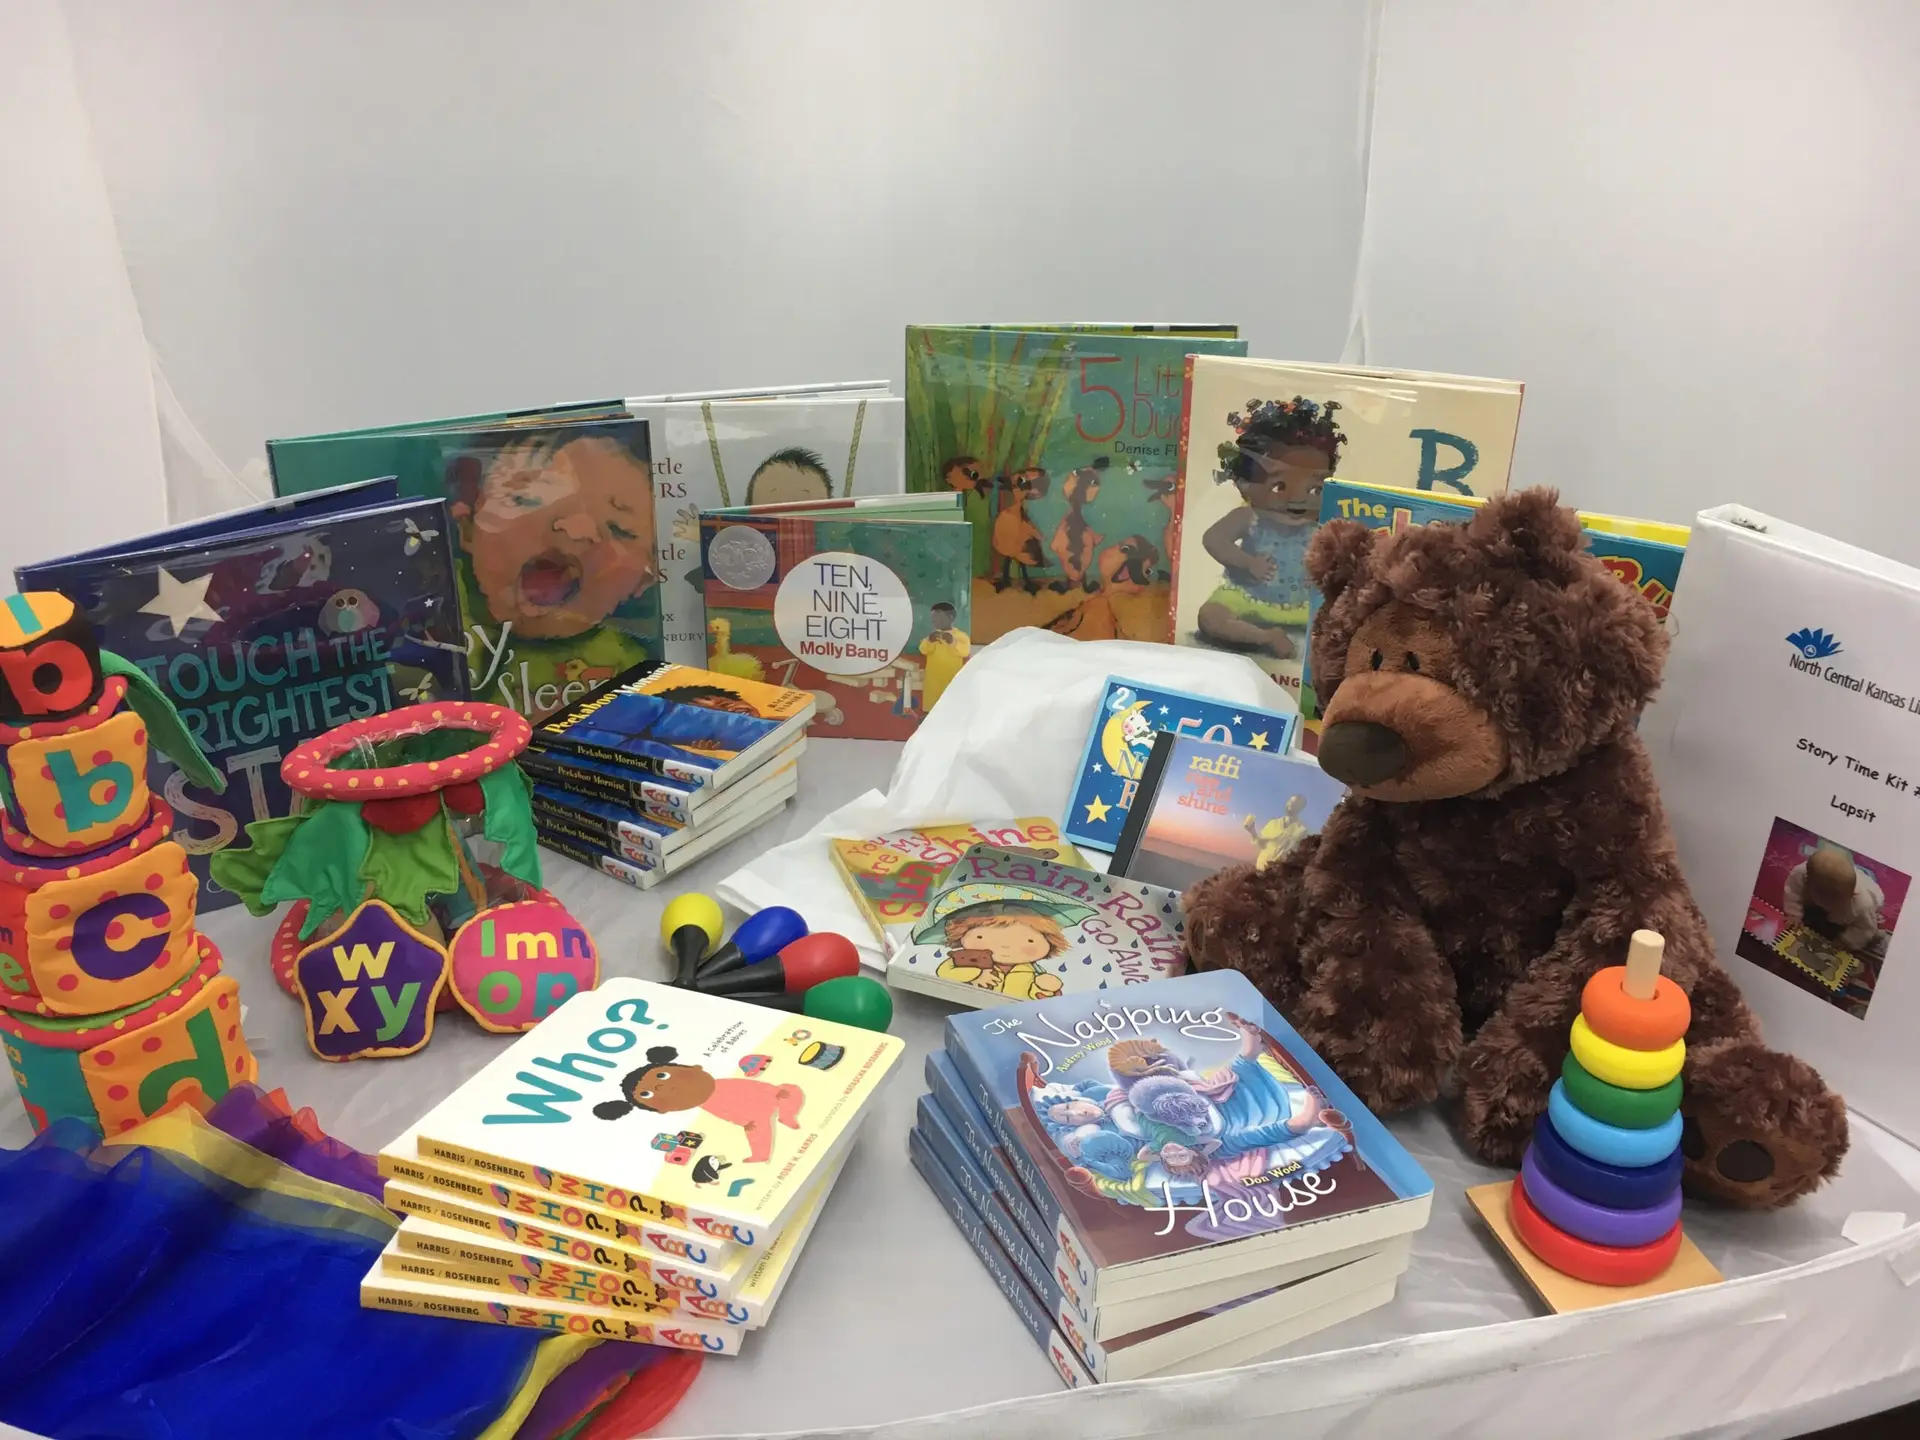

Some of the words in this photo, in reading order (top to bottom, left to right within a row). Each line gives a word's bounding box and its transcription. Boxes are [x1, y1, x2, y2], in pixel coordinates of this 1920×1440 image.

[1075, 357, 1126, 443] 5
[1133, 356, 1180, 398] Lit
[1114, 440, 1160, 457] Denise
[1337, 498, 1387, 520] The
[813, 562, 873, 591] TEN,
[813, 589, 883, 617] NINE,
[662, 632, 705, 642] NBURY
[806, 615, 887, 641] EIGHT
[135, 626, 321, 699] TOUCH
[329, 627, 391, 667] THE
[800, 640, 844, 659] Molly
[845, 643, 889, 662] Bang
[497, 661, 614, 716] Slee
[1789, 653, 1822, 678] North
[1824, 667, 1864, 693] Central
[1865, 681, 1906, 708] Kansas
[157, 663, 396, 763] RIGHTEST
[541, 692, 618, 735] Peekaboo
[1112, 686, 1131, 710] 2
[577, 745, 613, 761] Peekaboo
[1189, 754, 1243, 780] raffi
[1796, 738, 1838, 765] Story
[1845, 755, 1880, 780] Time
[1885, 773, 1909, 792] Kit
[557, 765, 592, 782] Peekaboo
[44, 749, 134, 833] b
[163, 744, 305, 856] ST
[1177, 791, 1229, 816] shine
[1830, 795, 1877, 823] Lapsit
[847, 835, 890, 857] You
[860, 853, 899, 884] Are
[890, 832, 932, 854] My
[967, 855, 1095, 902] Rain,
[707, 1020, 745, 1052] Celebration
[720, 1045, 731, 1054] of
[725, 1029, 748, 1046] Babies
[982, 1016, 1023, 1036] The
[1015, 1003, 1242, 1077] Napping
[138, 1007, 231, 1118] d
[482, 998, 670, 1125] Who?
[1055, 1045, 1088, 1074] Audrey
[1083, 1036, 1113, 1052] Wood
[434, 1148, 465, 1164] HARRIS
[474, 1158, 526, 1180] ROSENBERG
[979, 1083, 994, 1122] The
[994, 1112, 1026, 1180] Napping
[1024, 1164, 1050, 1216] House
[393, 1164, 425, 1181] HARRIS
[433, 1175, 484, 1197] ROSENBERG
[964, 1121, 981, 1154] The
[982, 1145, 1018, 1216] Napping
[1017, 1201, 1046, 1254] House
[1241, 1175, 1270, 1188] Don
[1267, 1161, 1303, 1179] Wood
[400, 1198, 432, 1214] HARRIS
[440, 1209, 492, 1230] ROSENBERG
[755, 1188, 775, 1212] written
[1143, 1172, 1337, 1236] House
[960, 1165, 978, 1202] The
[978, 1191, 1018, 1261] Napping
[1016, 1245, 1049, 1300] House
[416, 1240, 450, 1256] HARRIS
[459, 1249, 514, 1269] ROSENBERG
[952, 1196, 970, 1235] The
[971, 1225, 1010, 1294] Napping
[1007, 1278, 1040, 1334] House
[401, 1262, 436, 1277] HARRIS
[445, 1270, 501, 1287] ROSENBERG
[750, 1260, 768, 1289] written
[378, 1295, 413, 1308] HARRIS
[423, 1301, 480, 1316] ROSENBERG
